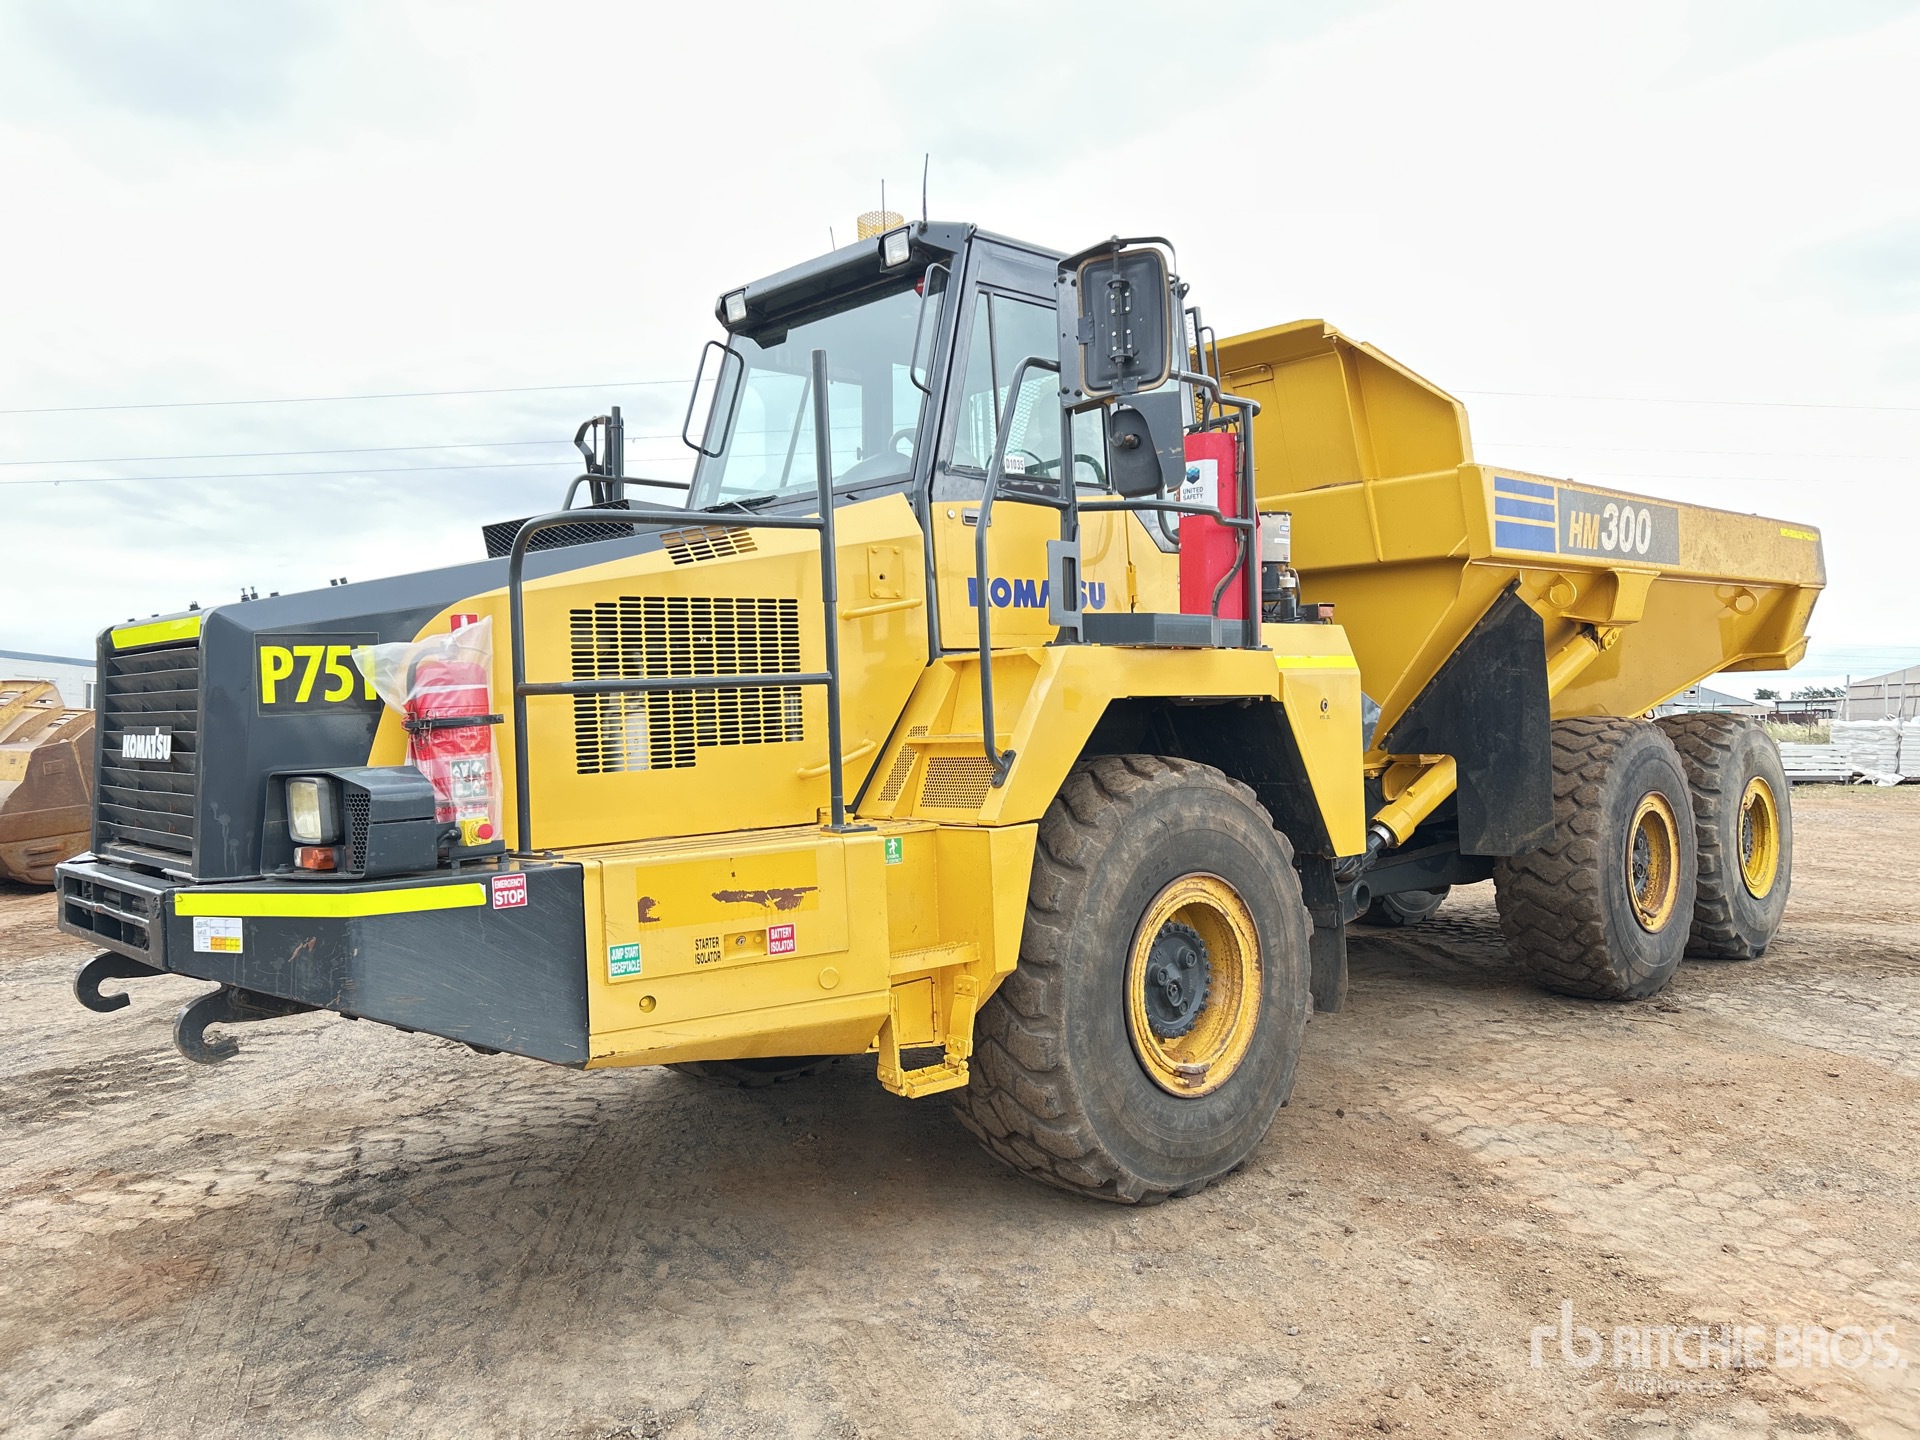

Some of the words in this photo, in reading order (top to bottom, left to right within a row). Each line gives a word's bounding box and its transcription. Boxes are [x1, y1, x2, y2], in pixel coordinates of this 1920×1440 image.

[122, 726, 172, 760] KOMATSU
[494, 877, 524, 889] EMERGENCY
[495, 889, 525, 905] STOP
[770, 926, 793, 939] BATTERY
[695, 937, 720, 950] STARTER
[770, 939, 794, 952] ISOLATOR
[611, 947, 624, 960] JUMP
[624, 945, 639, 959] START
[694, 951, 721, 964] ISOLATOR
[611, 959, 641, 974] RECEPTACLE
